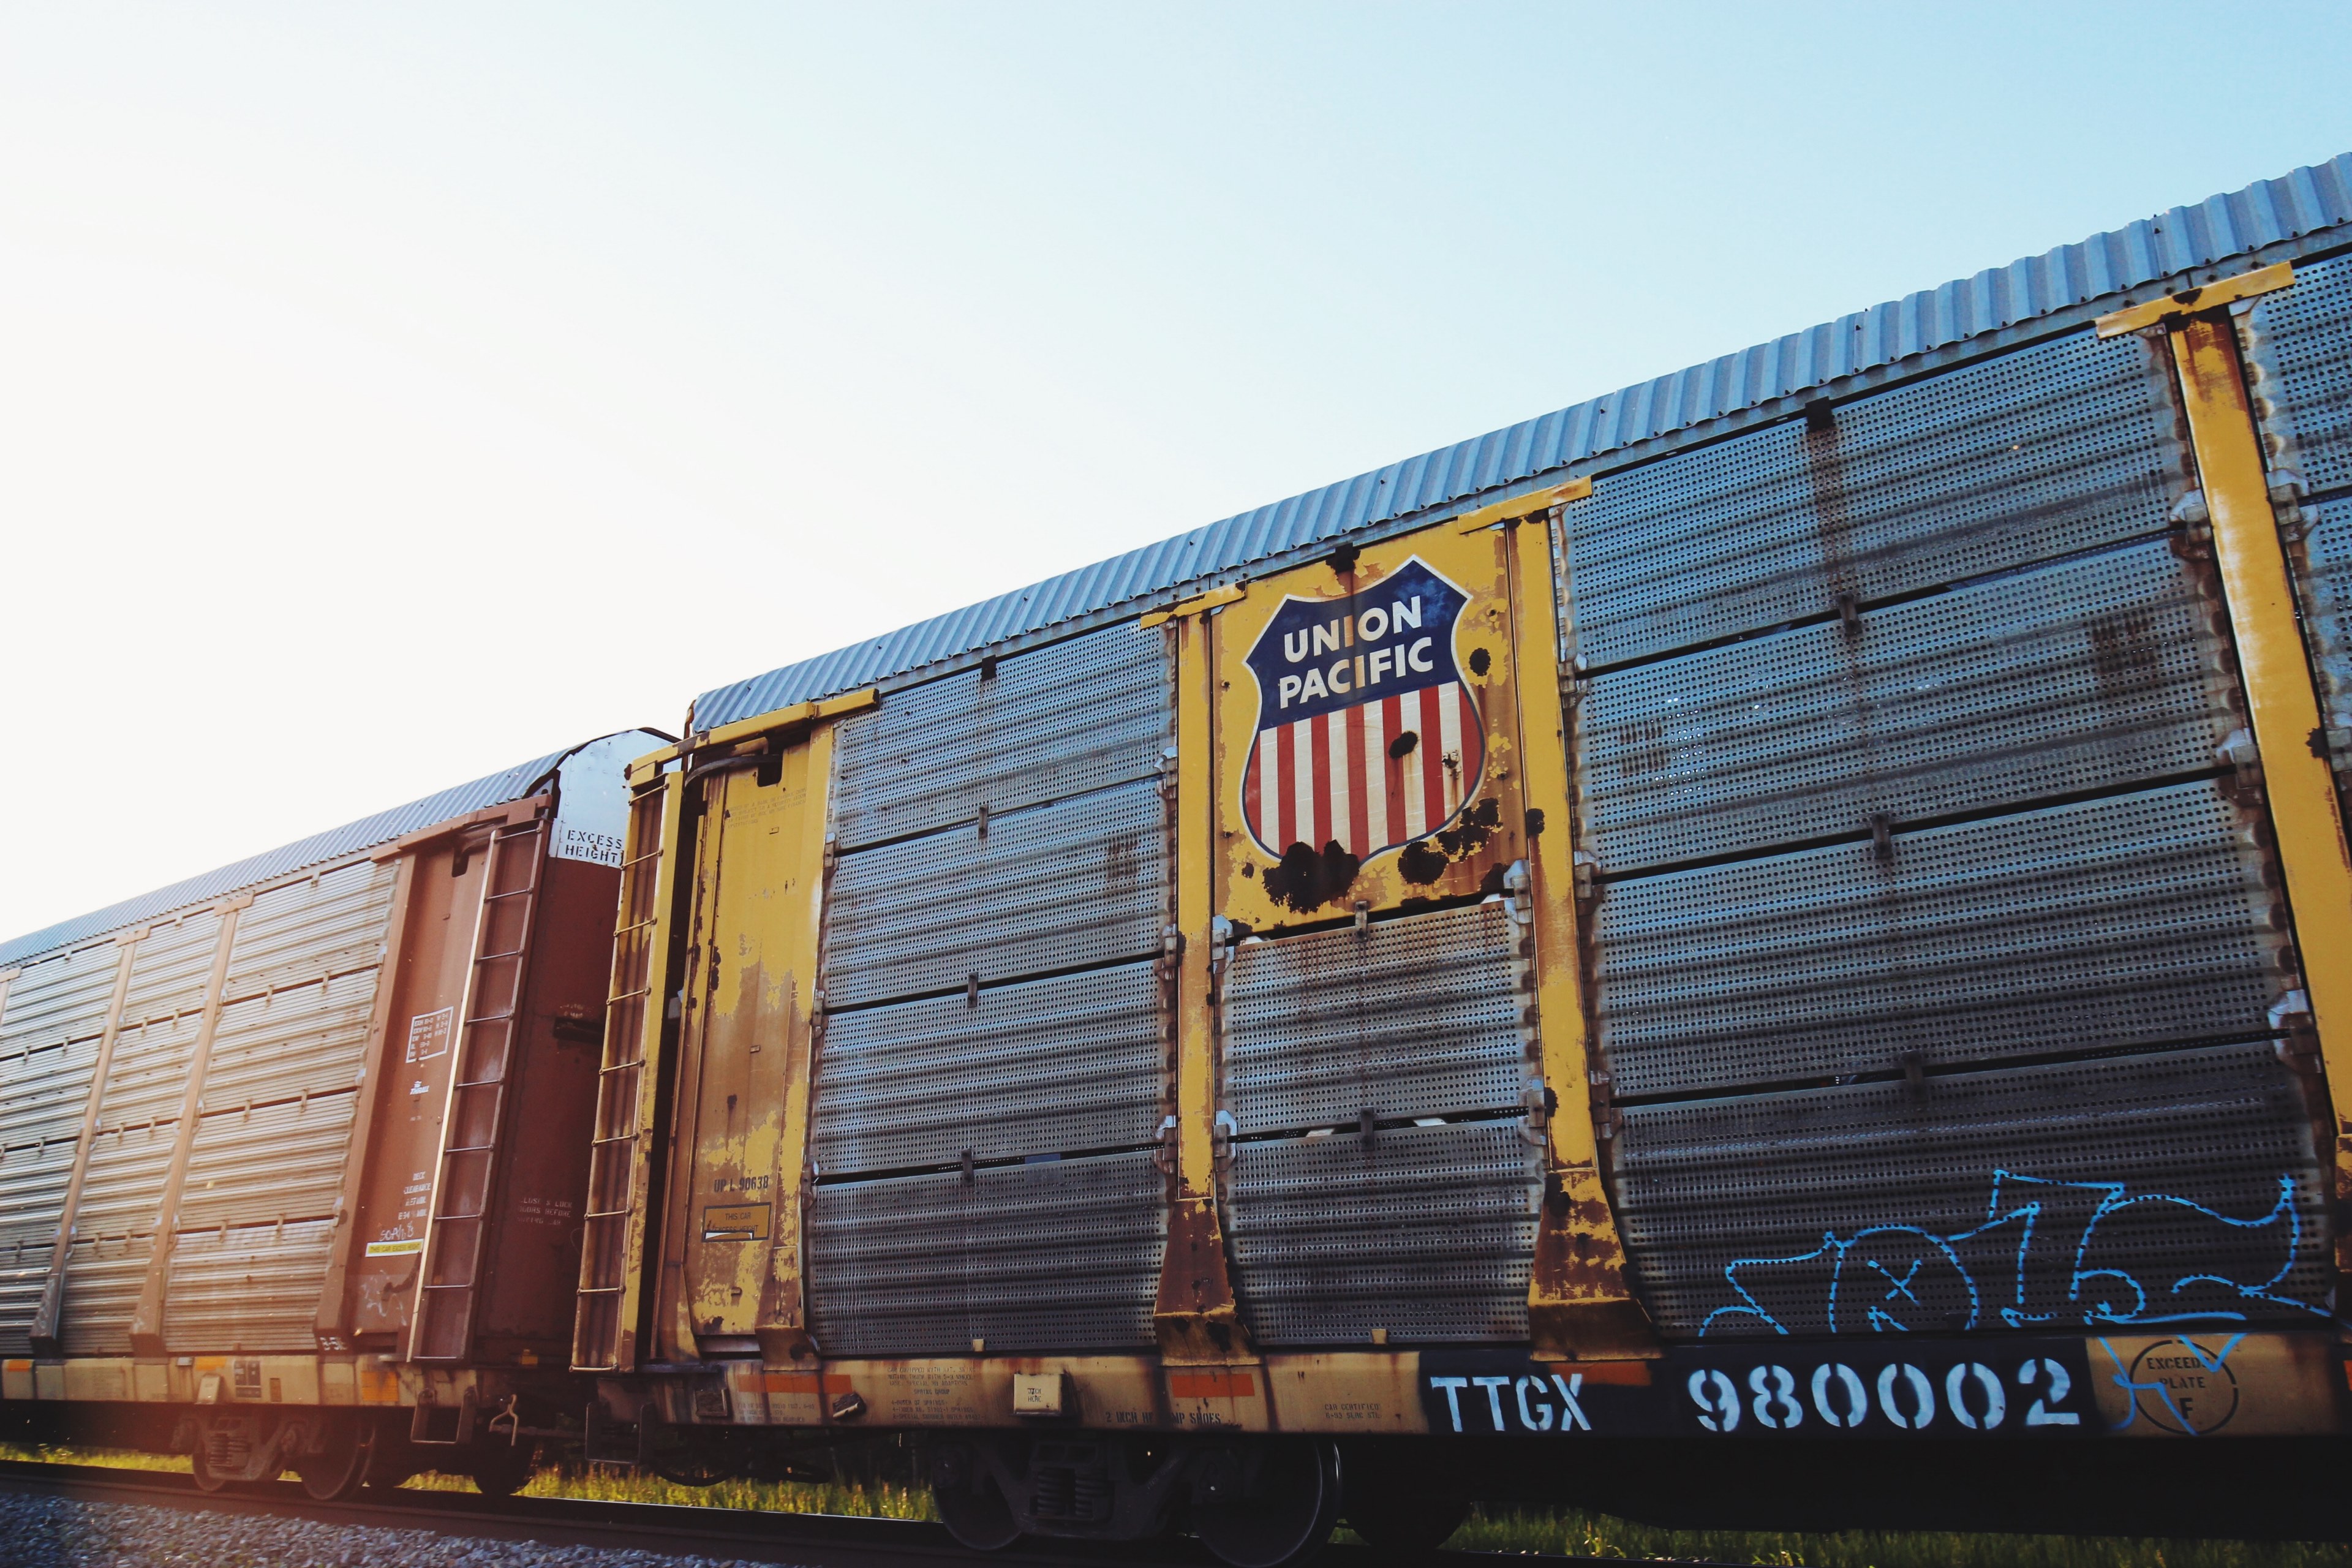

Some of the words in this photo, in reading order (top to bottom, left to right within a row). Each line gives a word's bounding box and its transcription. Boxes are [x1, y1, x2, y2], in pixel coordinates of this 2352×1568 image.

[1284, 595, 1422, 663] UNION
[1280, 637, 1433, 709] PACIFIC
[567, 829, 622, 849] EXCESS
[565, 845, 618, 863] HEIGHT
[739, 1175, 769, 1191] 90638
[545, 1208, 571, 1218] BEFORE
[1430, 1373, 1592, 1432] TTGX
[1688, 1358, 2080, 1432] 980002
[1106, 1411, 1112, 1422] 2
[1115, 1411, 1138, 1423] INCH
[1189, 1412, 1221, 1425] SHOES
[2179, 1397, 2193, 1419] F
